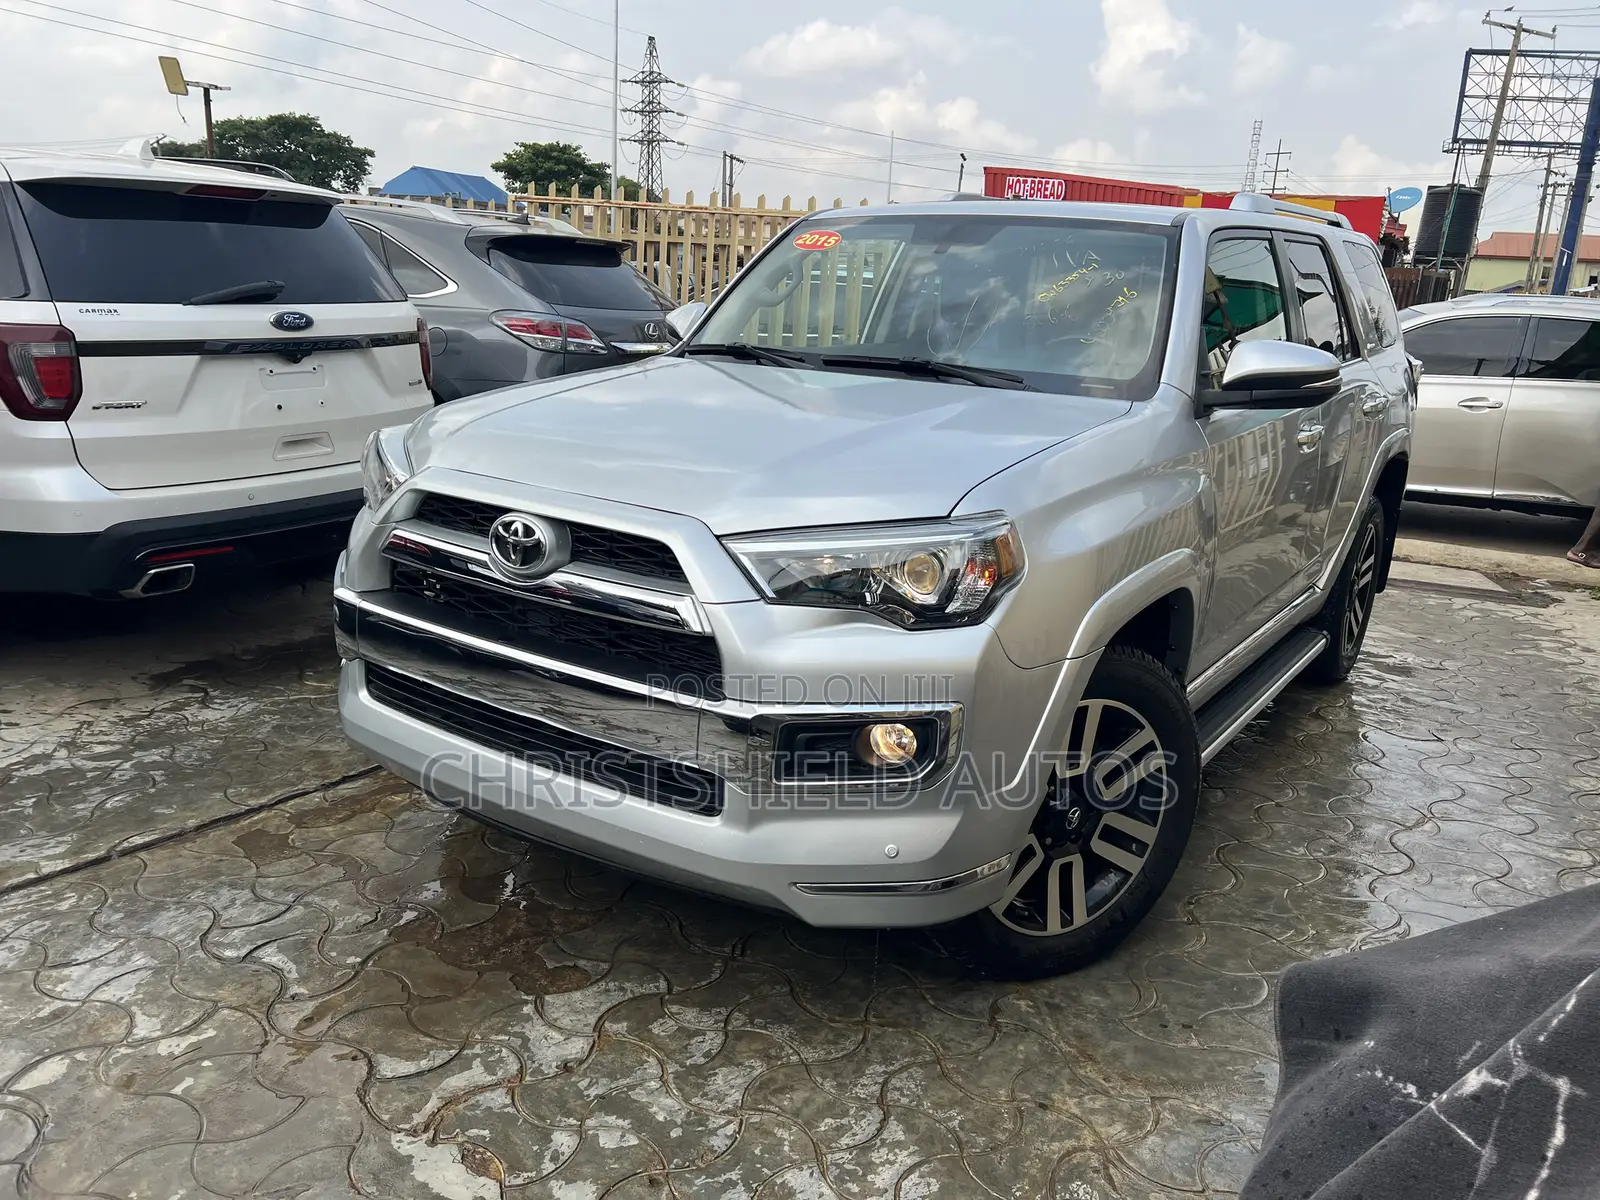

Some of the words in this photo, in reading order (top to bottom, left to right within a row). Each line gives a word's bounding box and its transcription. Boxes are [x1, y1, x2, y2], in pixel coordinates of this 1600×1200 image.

[795, 234, 840, 247] 2015
[282, 313, 307, 327] Ford
[231, 339, 352, 353] EXPLORER
[92, 400, 147, 410] SPORT
